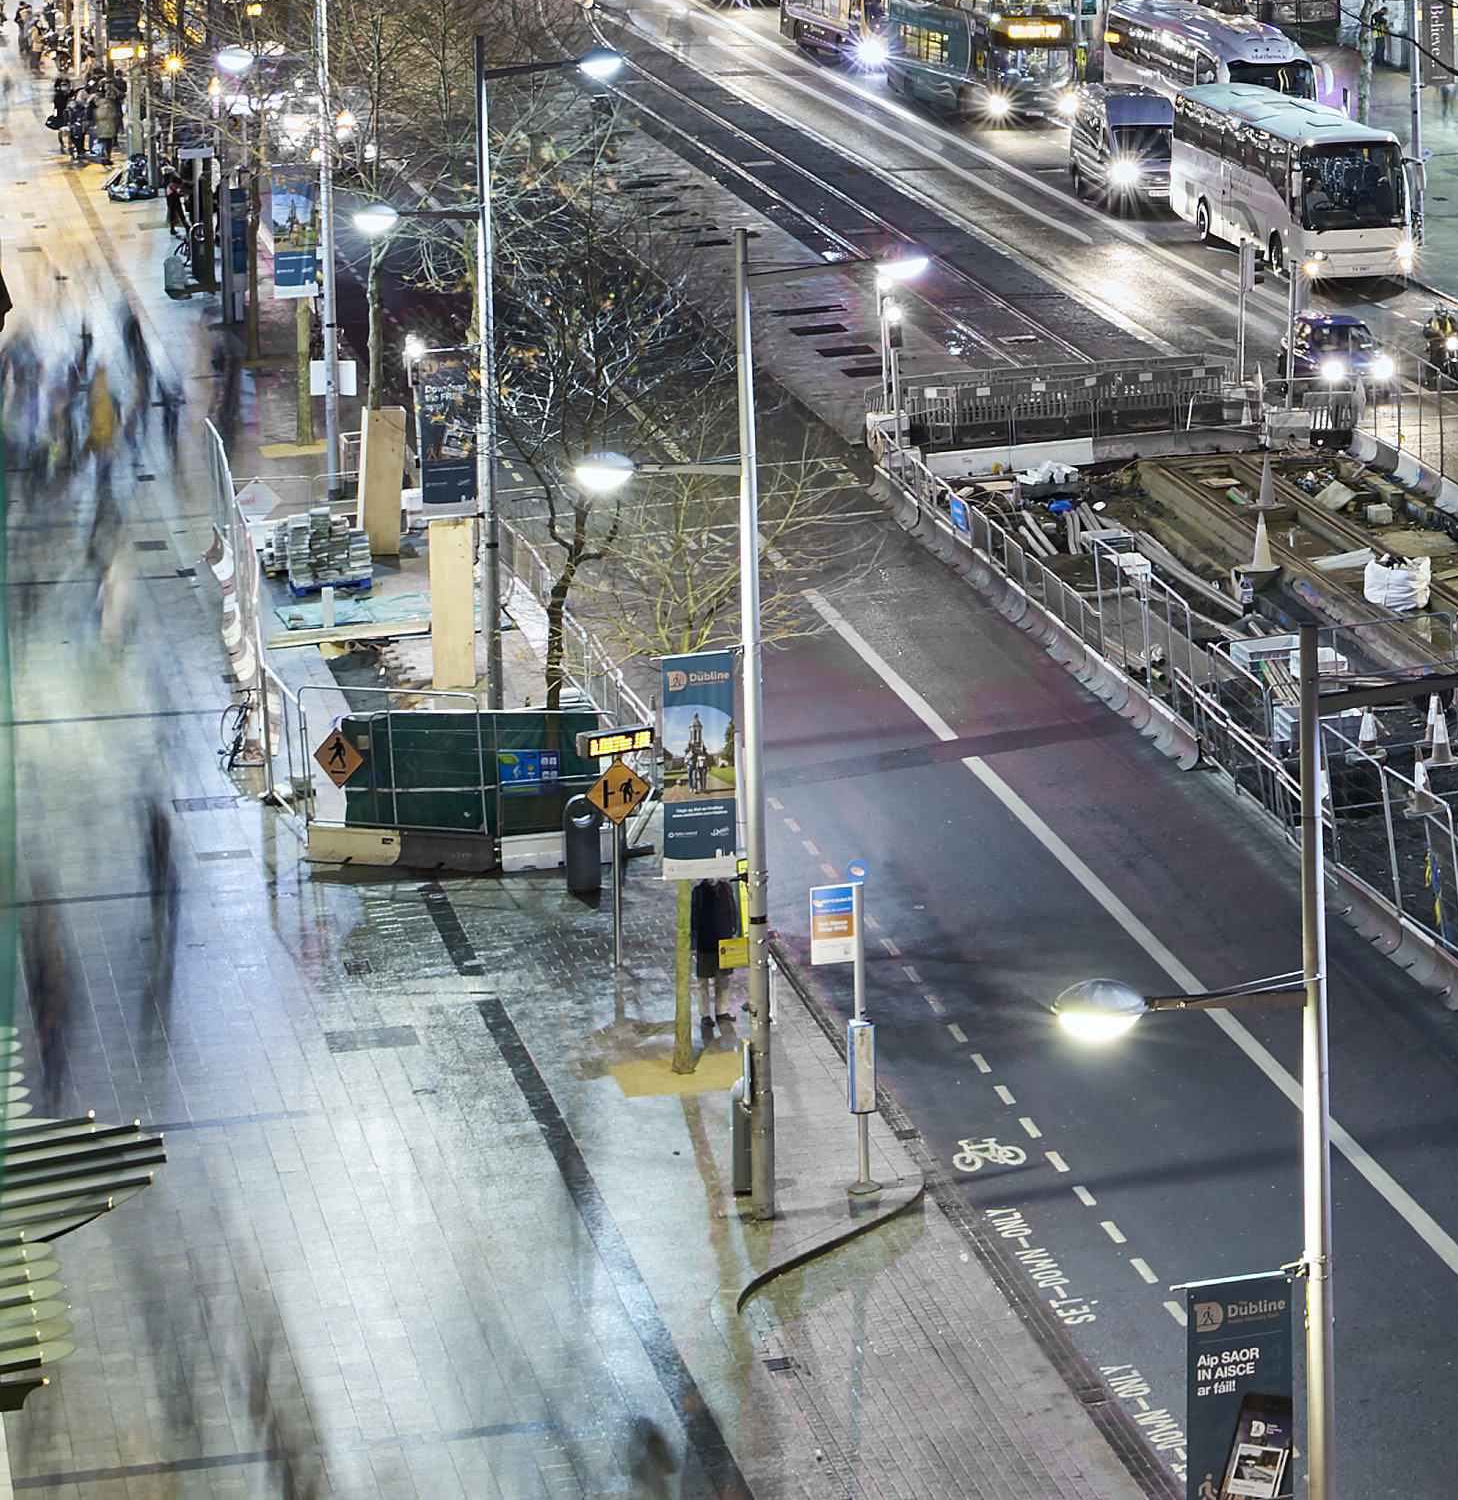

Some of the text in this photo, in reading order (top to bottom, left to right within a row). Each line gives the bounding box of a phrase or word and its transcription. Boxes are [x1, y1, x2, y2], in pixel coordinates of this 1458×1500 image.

[689, 670, 730, 682] Dubline
[1227, 1299, 1286, 1318] Dubline
[1197, 1347, 1260, 1368] Aip SAOR
[1198, 1362, 1256, 1381] IN AISCE
[1197, 1380, 1236, 1396] ar fáil!
